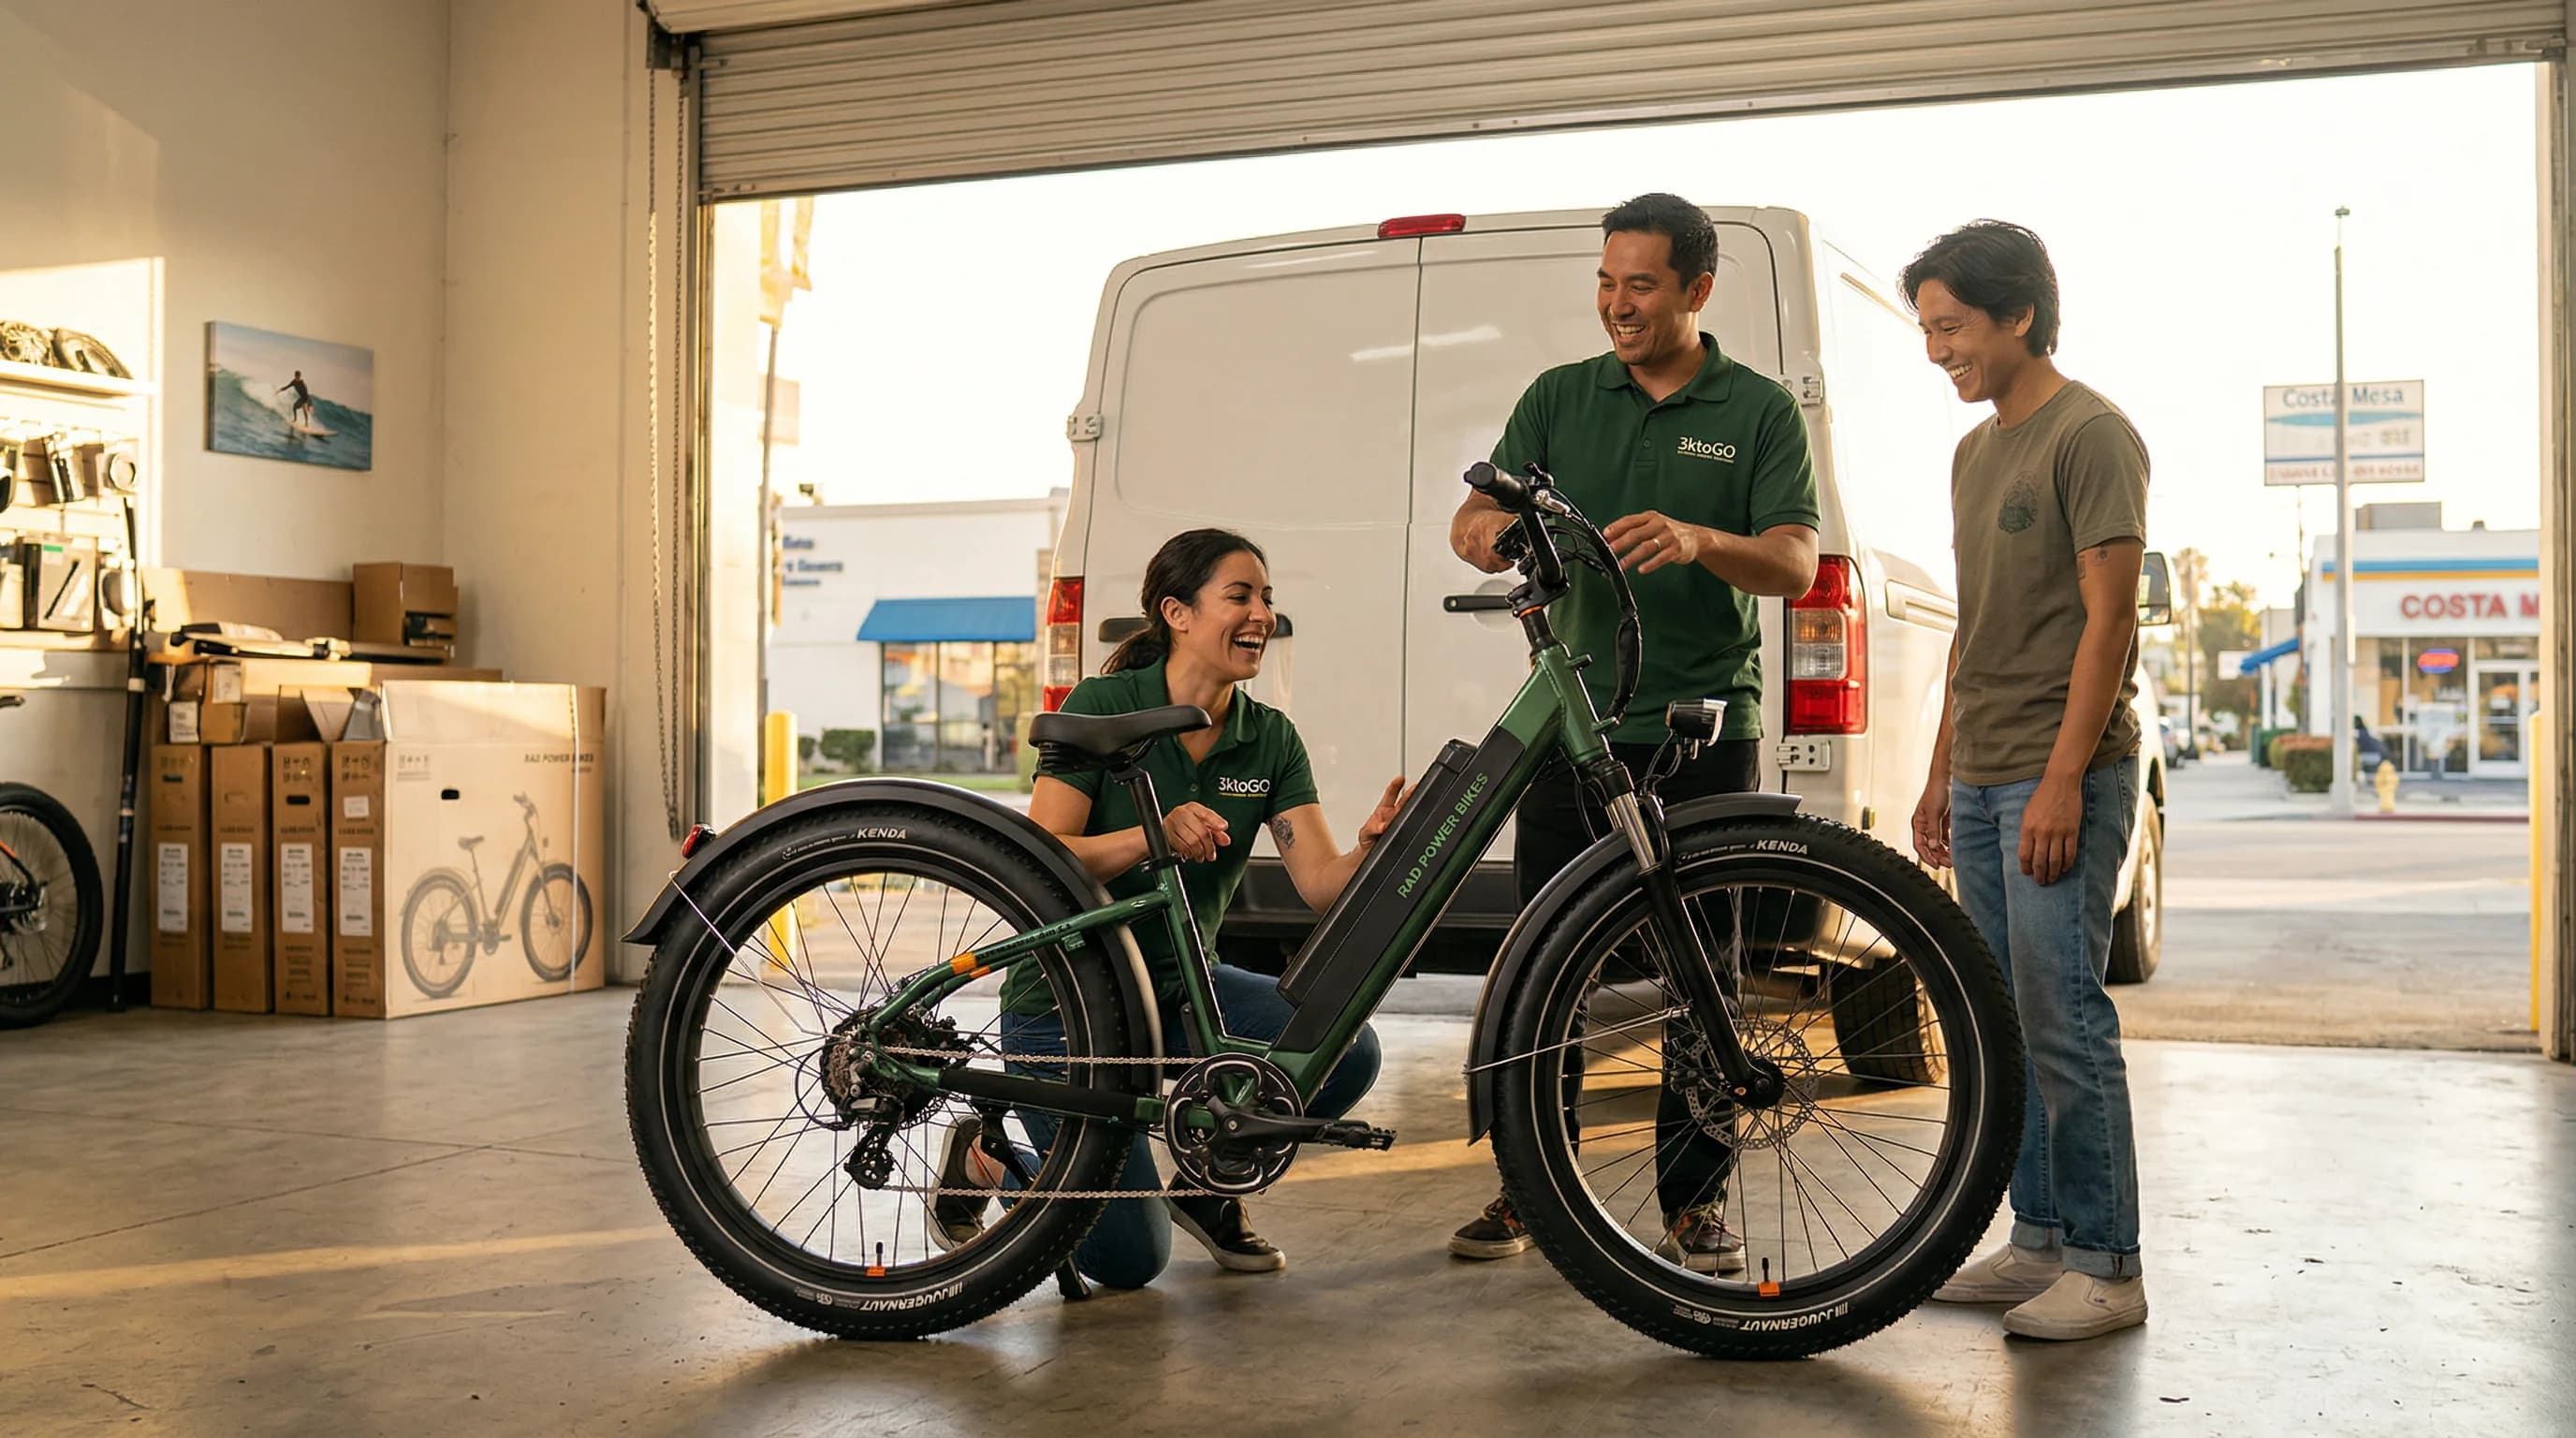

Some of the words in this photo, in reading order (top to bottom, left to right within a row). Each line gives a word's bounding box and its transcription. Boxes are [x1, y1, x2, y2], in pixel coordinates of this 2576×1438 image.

[2352, 387, 2404, 404] Mesa
[1676, 436, 1736, 458] 3ktoGO
[2400, 593, 2507, 620] COSTA
[1218, 776, 1270, 793] 3ktoGO
[856, 828, 907, 840] KENDA
[1397, 867, 1422, 899] RAD
[1418, 814, 1460, 868] POWER
[1454, 772, 1489, 815] BIKES
[1756, 839, 1808, 855] KENDA
